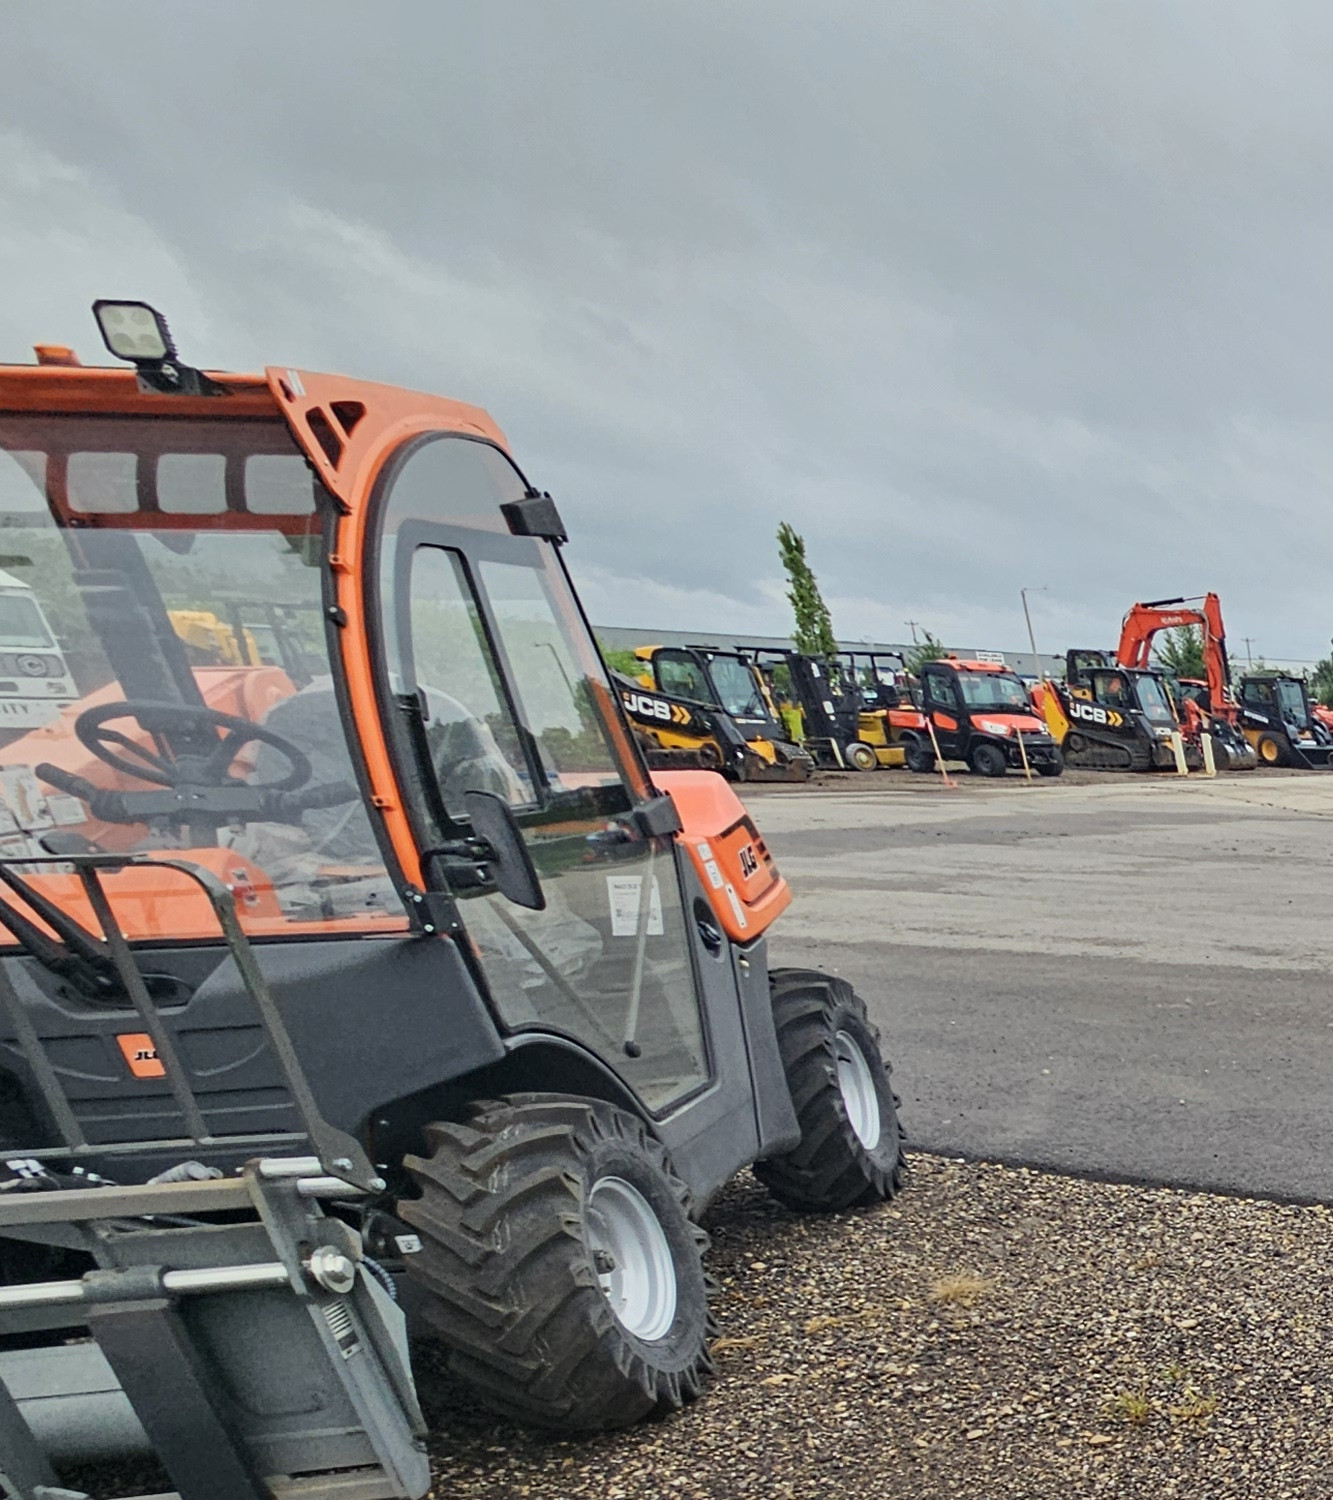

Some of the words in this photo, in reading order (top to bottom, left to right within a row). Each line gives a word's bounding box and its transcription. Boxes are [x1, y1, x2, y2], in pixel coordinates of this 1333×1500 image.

[0, 703, 28, 714] ITY
[625, 694, 671, 720] JCB
[1070, 703, 1107, 724] JCB
[738, 845, 759, 880] JLG
